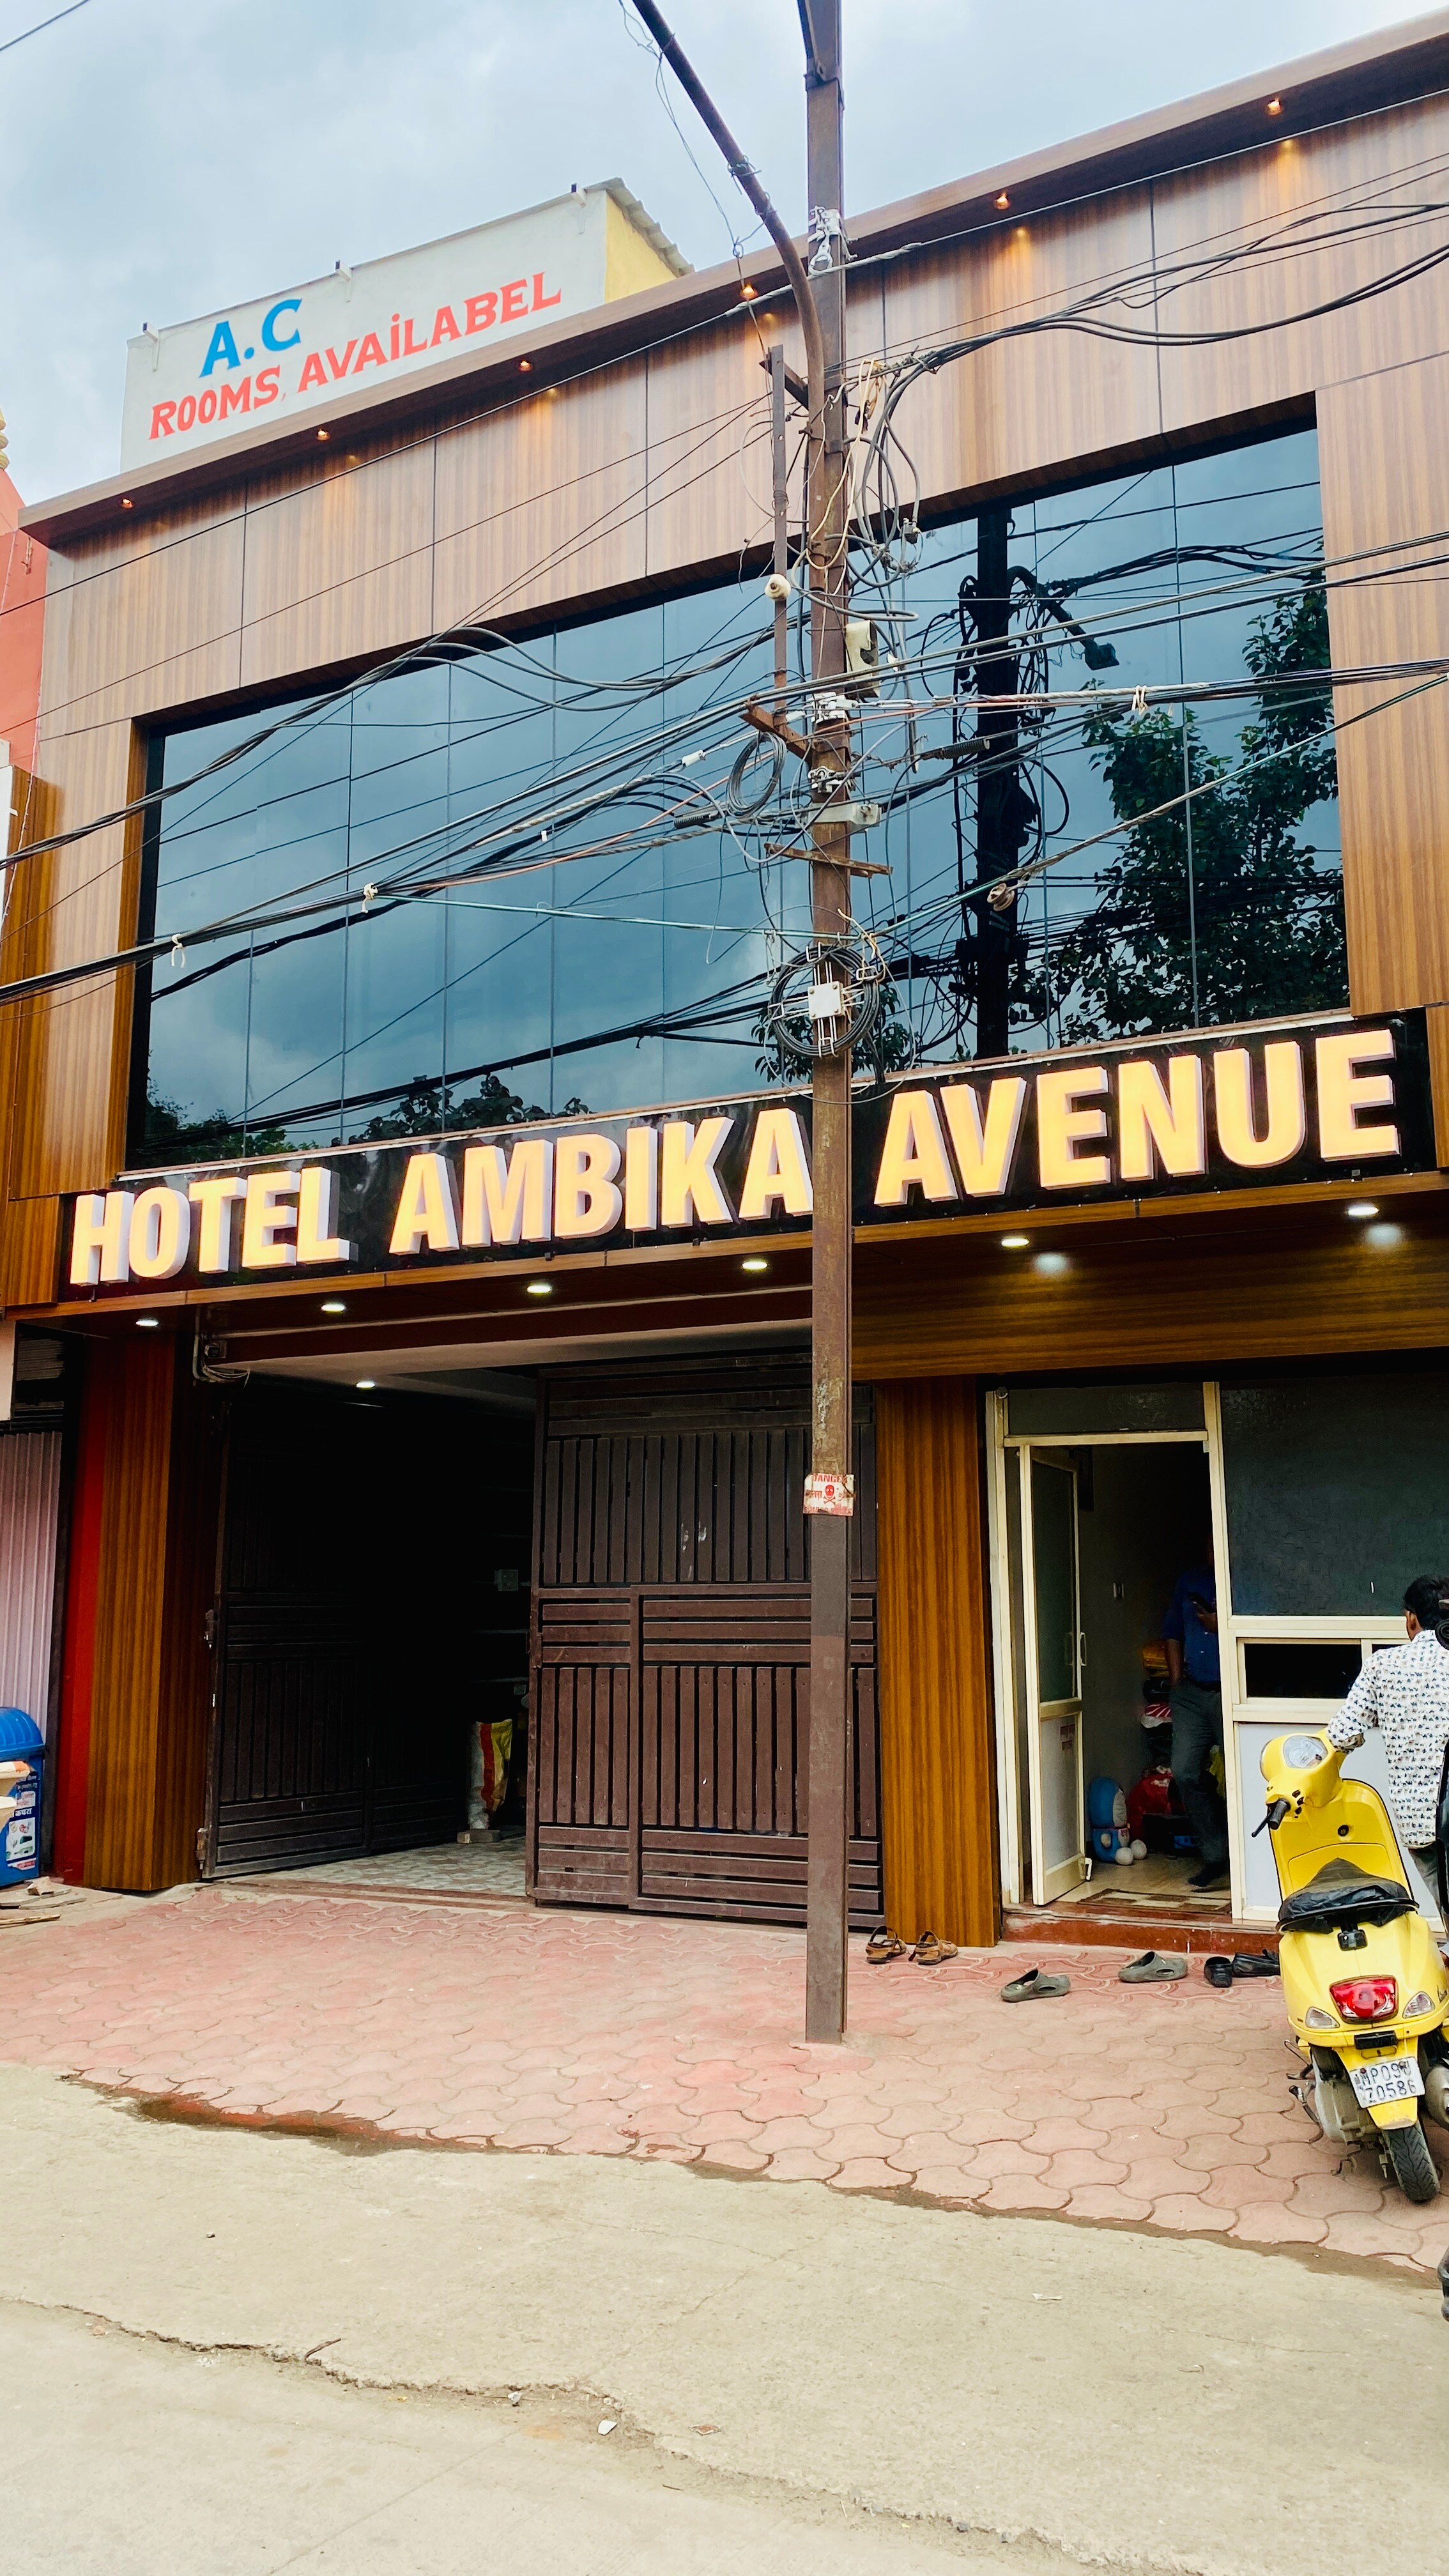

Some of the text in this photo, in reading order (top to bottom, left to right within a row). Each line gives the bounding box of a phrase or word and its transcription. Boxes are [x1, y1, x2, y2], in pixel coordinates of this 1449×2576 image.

[198, 298, 303, 378] A.C
[148, 365, 282, 441] ROOMS
[68, 1029, 1400, 1287] HOTEL AMBIKA AVENUE
